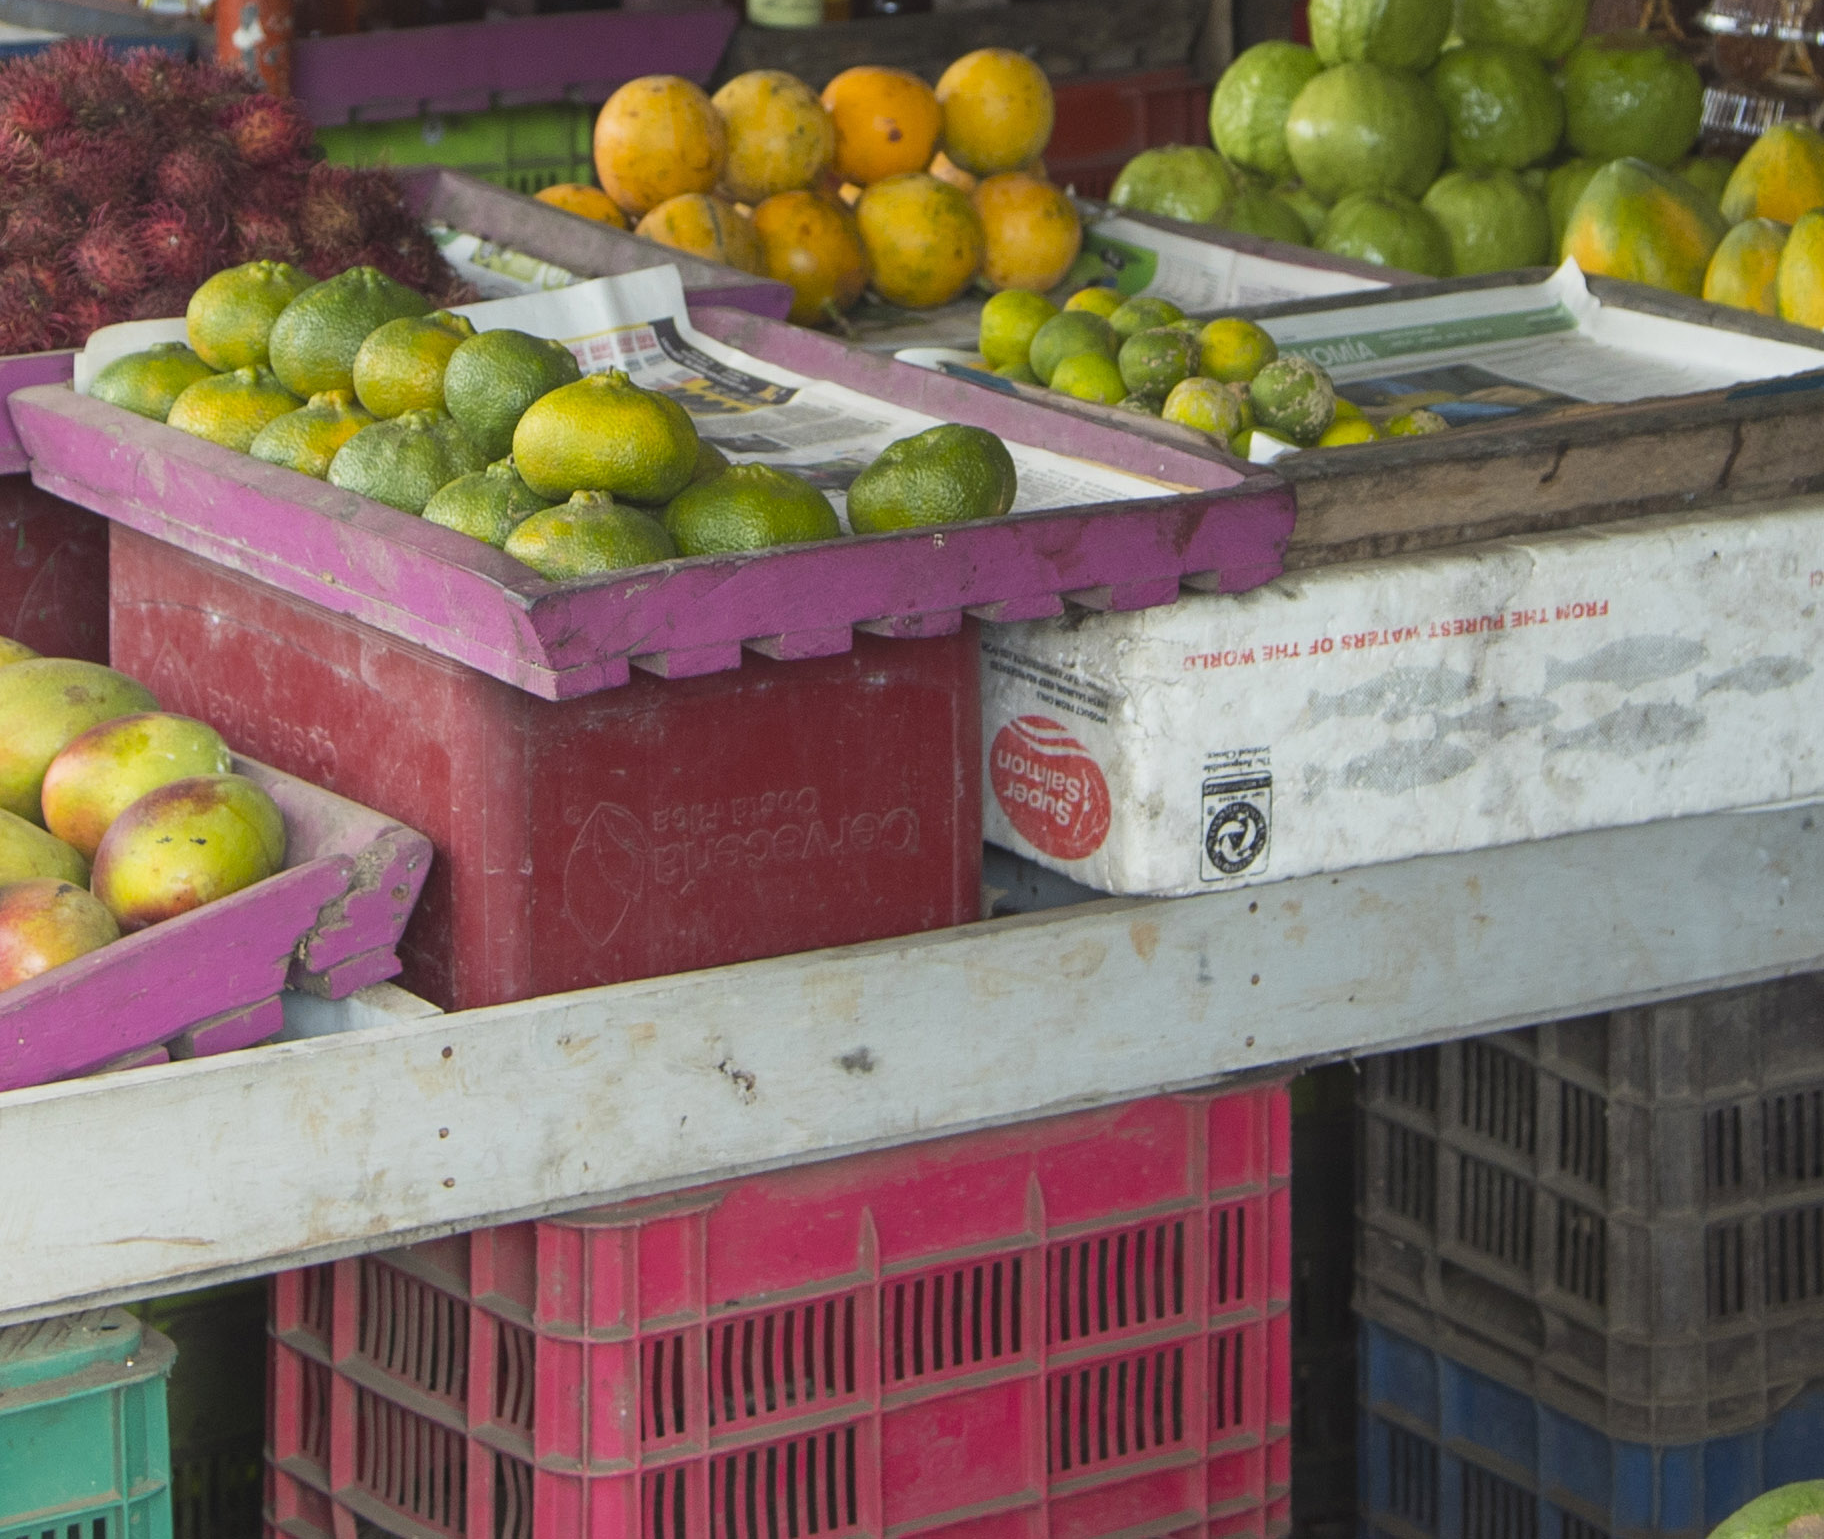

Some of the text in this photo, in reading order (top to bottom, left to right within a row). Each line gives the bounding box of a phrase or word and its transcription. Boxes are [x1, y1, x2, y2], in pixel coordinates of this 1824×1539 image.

[1510, 608, 1549, 629] THE
[1555, 599, 1610, 620] FROM
[1340, 625, 1421, 652] WATERS
[1427, 613, 1506, 639] PUREST
[1262, 639, 1303, 663] THE
[1306, 636, 1334, 655] OF
[997, 750, 1081, 801] Salmon
[1003, 781, 1072, 826] Super
